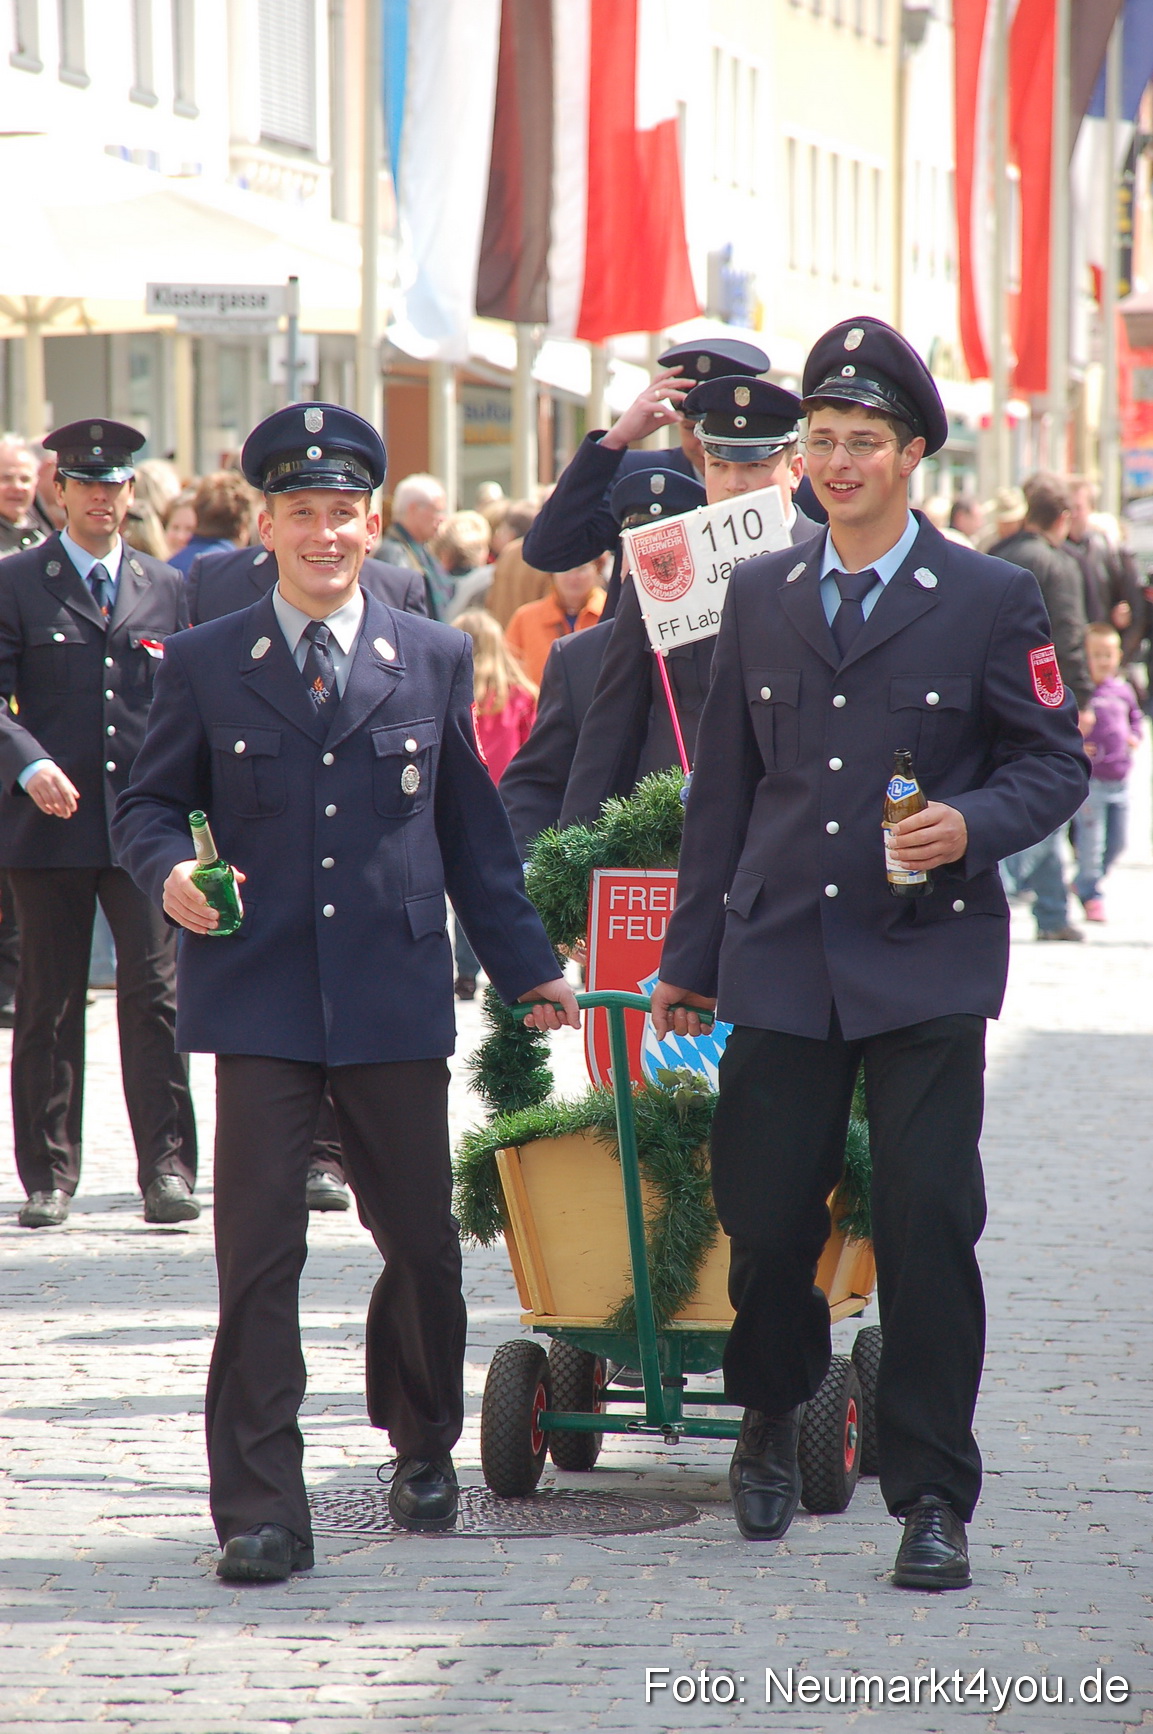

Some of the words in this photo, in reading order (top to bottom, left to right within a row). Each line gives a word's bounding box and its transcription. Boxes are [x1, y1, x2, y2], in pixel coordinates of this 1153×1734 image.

[153, 286, 268, 313] Klostergasse
[635, 526, 681, 548] FREIWILLIGE
[701, 508, 763, 552] 110
[637, 536, 684, 557] FEUERWEHR
[658, 618, 680, 640] FF
[686, 608, 723, 631] Lab
[609, 886, 675, 911] FREI
[608, 916, 667, 941] FEU
